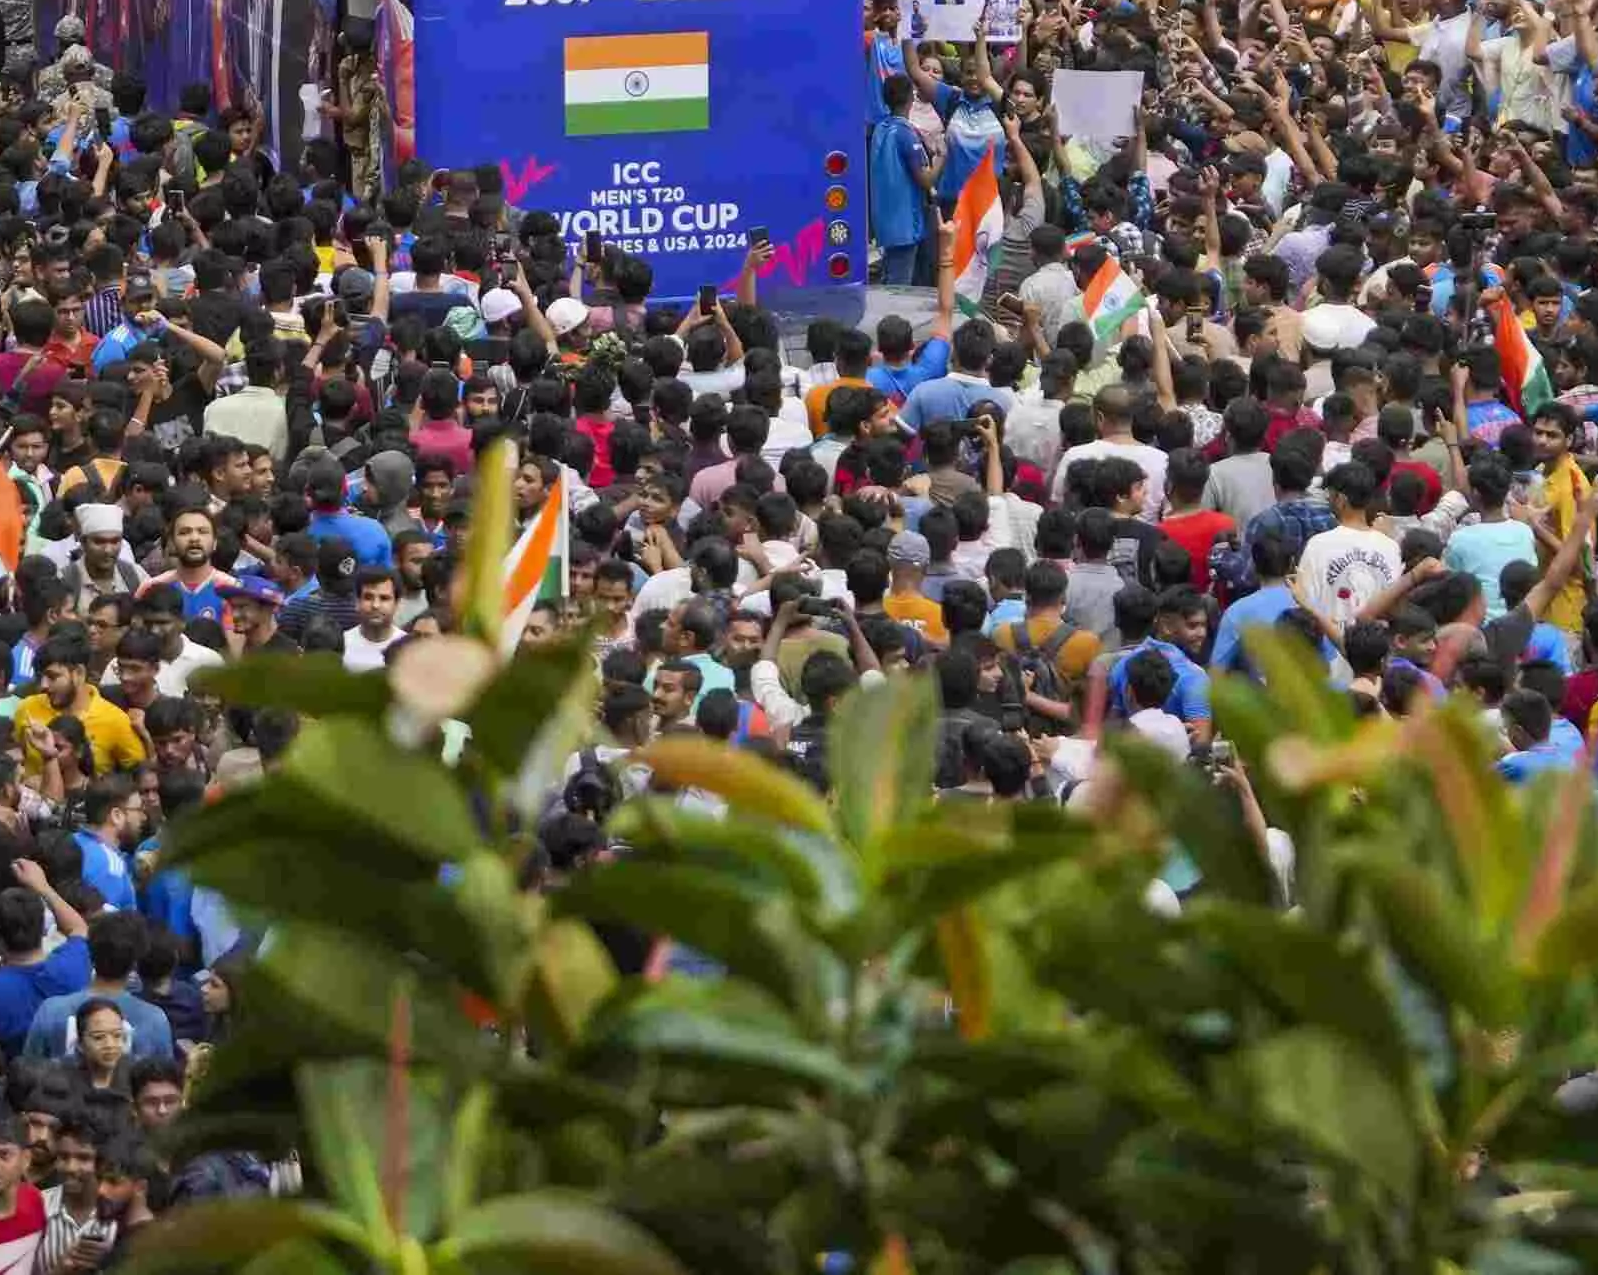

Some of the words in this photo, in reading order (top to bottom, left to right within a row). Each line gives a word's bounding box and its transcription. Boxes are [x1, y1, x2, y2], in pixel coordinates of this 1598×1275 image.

[612, 162, 661, 185] ICC
[590, 189, 647, 207] MEN'S
[652, 187, 685, 204] T20
[671, 203, 739, 231] CUP
[647, 238, 660, 253] &
[664, 236, 699, 252] USA
[704, 232, 747, 249] 2024
